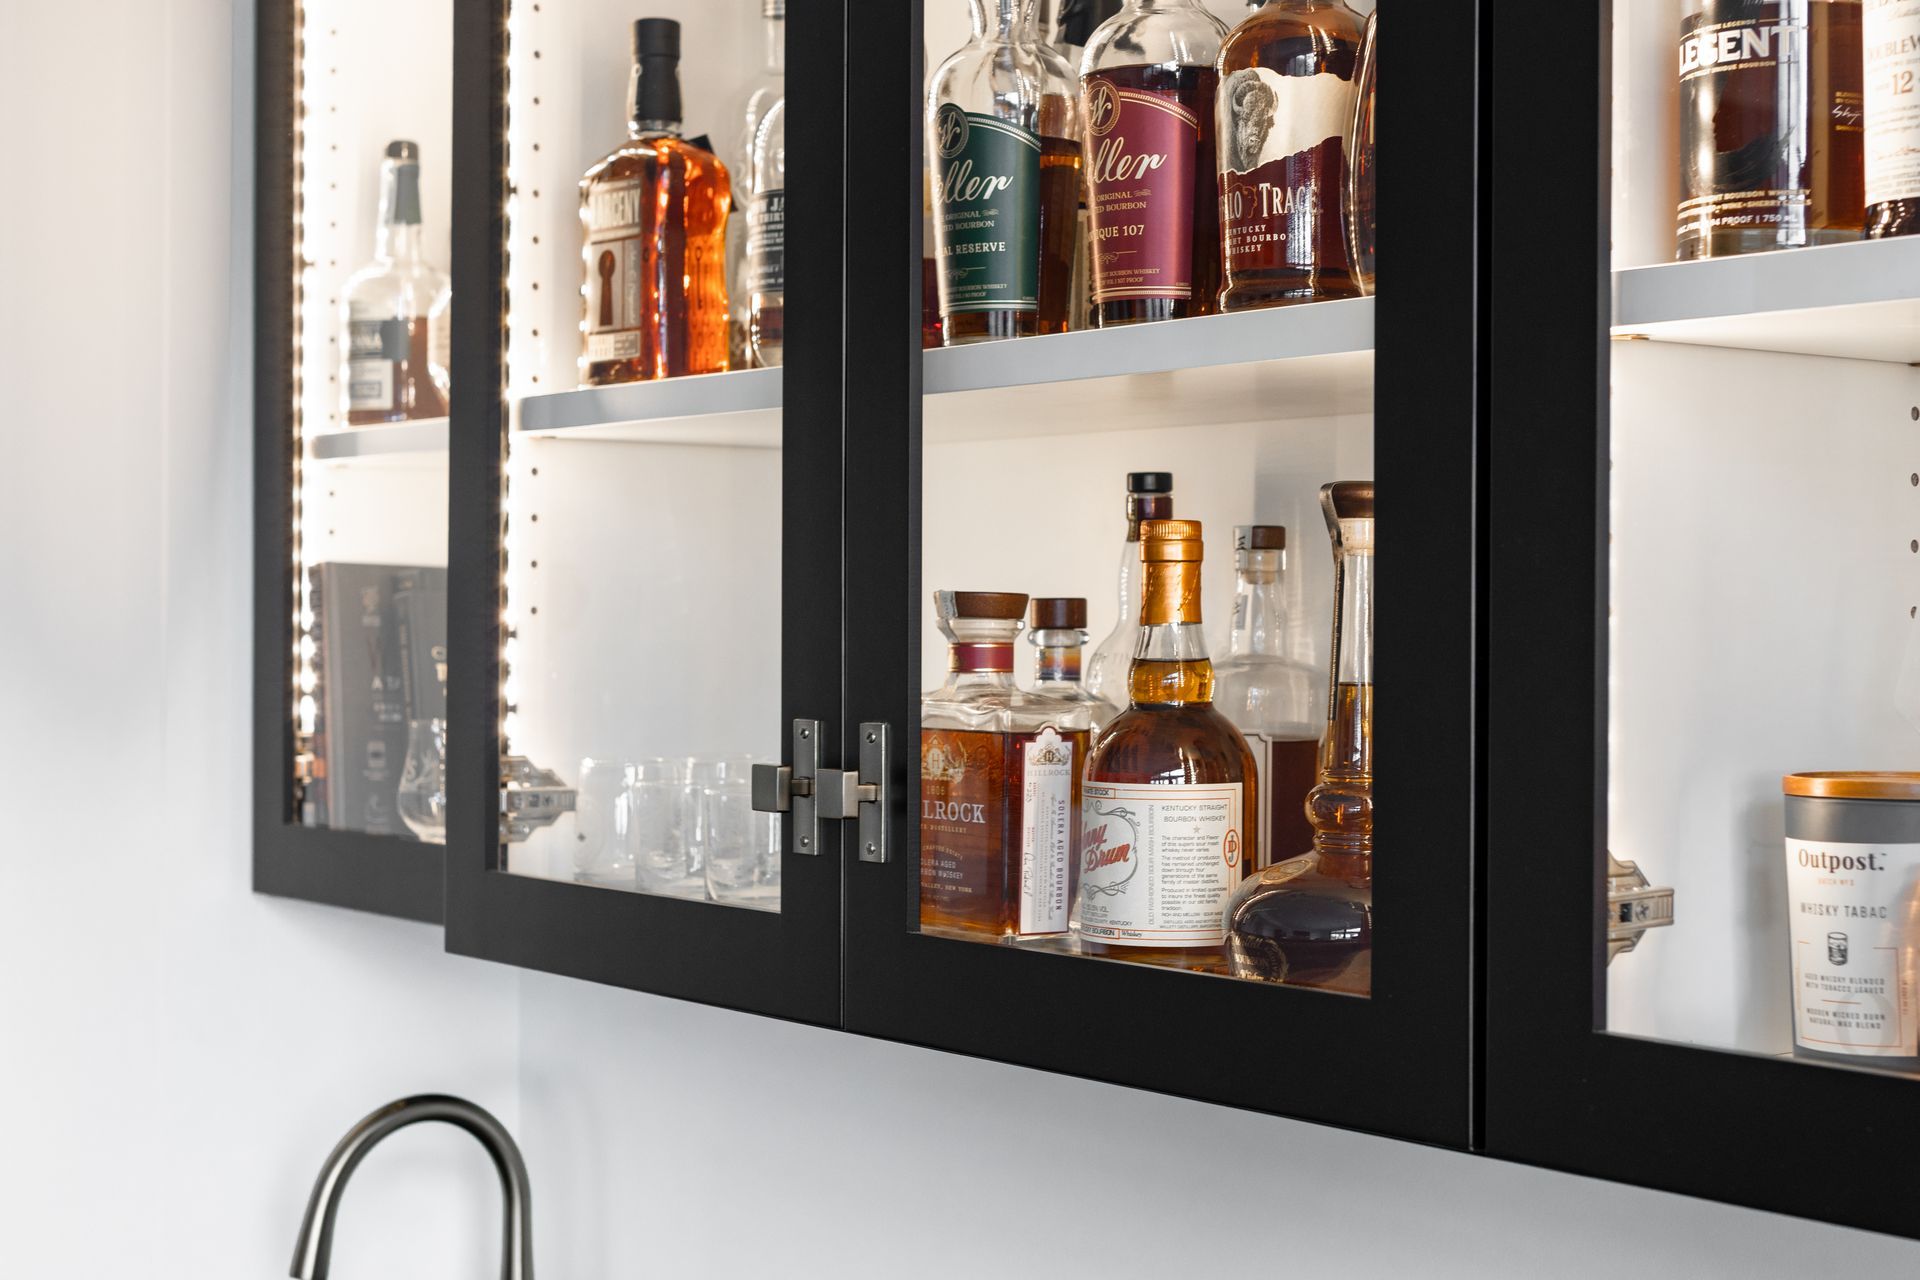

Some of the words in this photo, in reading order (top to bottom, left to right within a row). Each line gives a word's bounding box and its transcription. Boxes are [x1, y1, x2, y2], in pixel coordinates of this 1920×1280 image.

[1891, 69, 1914, 96] 12
[1096, 192, 1132, 202] ORIGINAL
[1258, 182, 1318, 218] TRACE
[1106, 202, 1147, 212] BOURBON
[955, 220, 995, 230] BOURBON
[1721, 215, 1752, 225] PROOF
[1762, 214, 1781, 222] 750
[1122, 224, 1145, 236] 107
[955, 241, 1006, 255] RESERVE
[1161, 804, 1197, 812] KENTUCKY
[1199, 803, 1228, 811] STRAIGHT
[1057, 800, 1066, 835] SOLERA
[1163, 815, 1197, 823] BOURBON
[1056, 839, 1065, 863] AGED
[1055, 867, 1064, 911] BOURBON
[1800, 902, 1840, 917] WHISKY
[1843, 905, 1888, 919] TABAC
